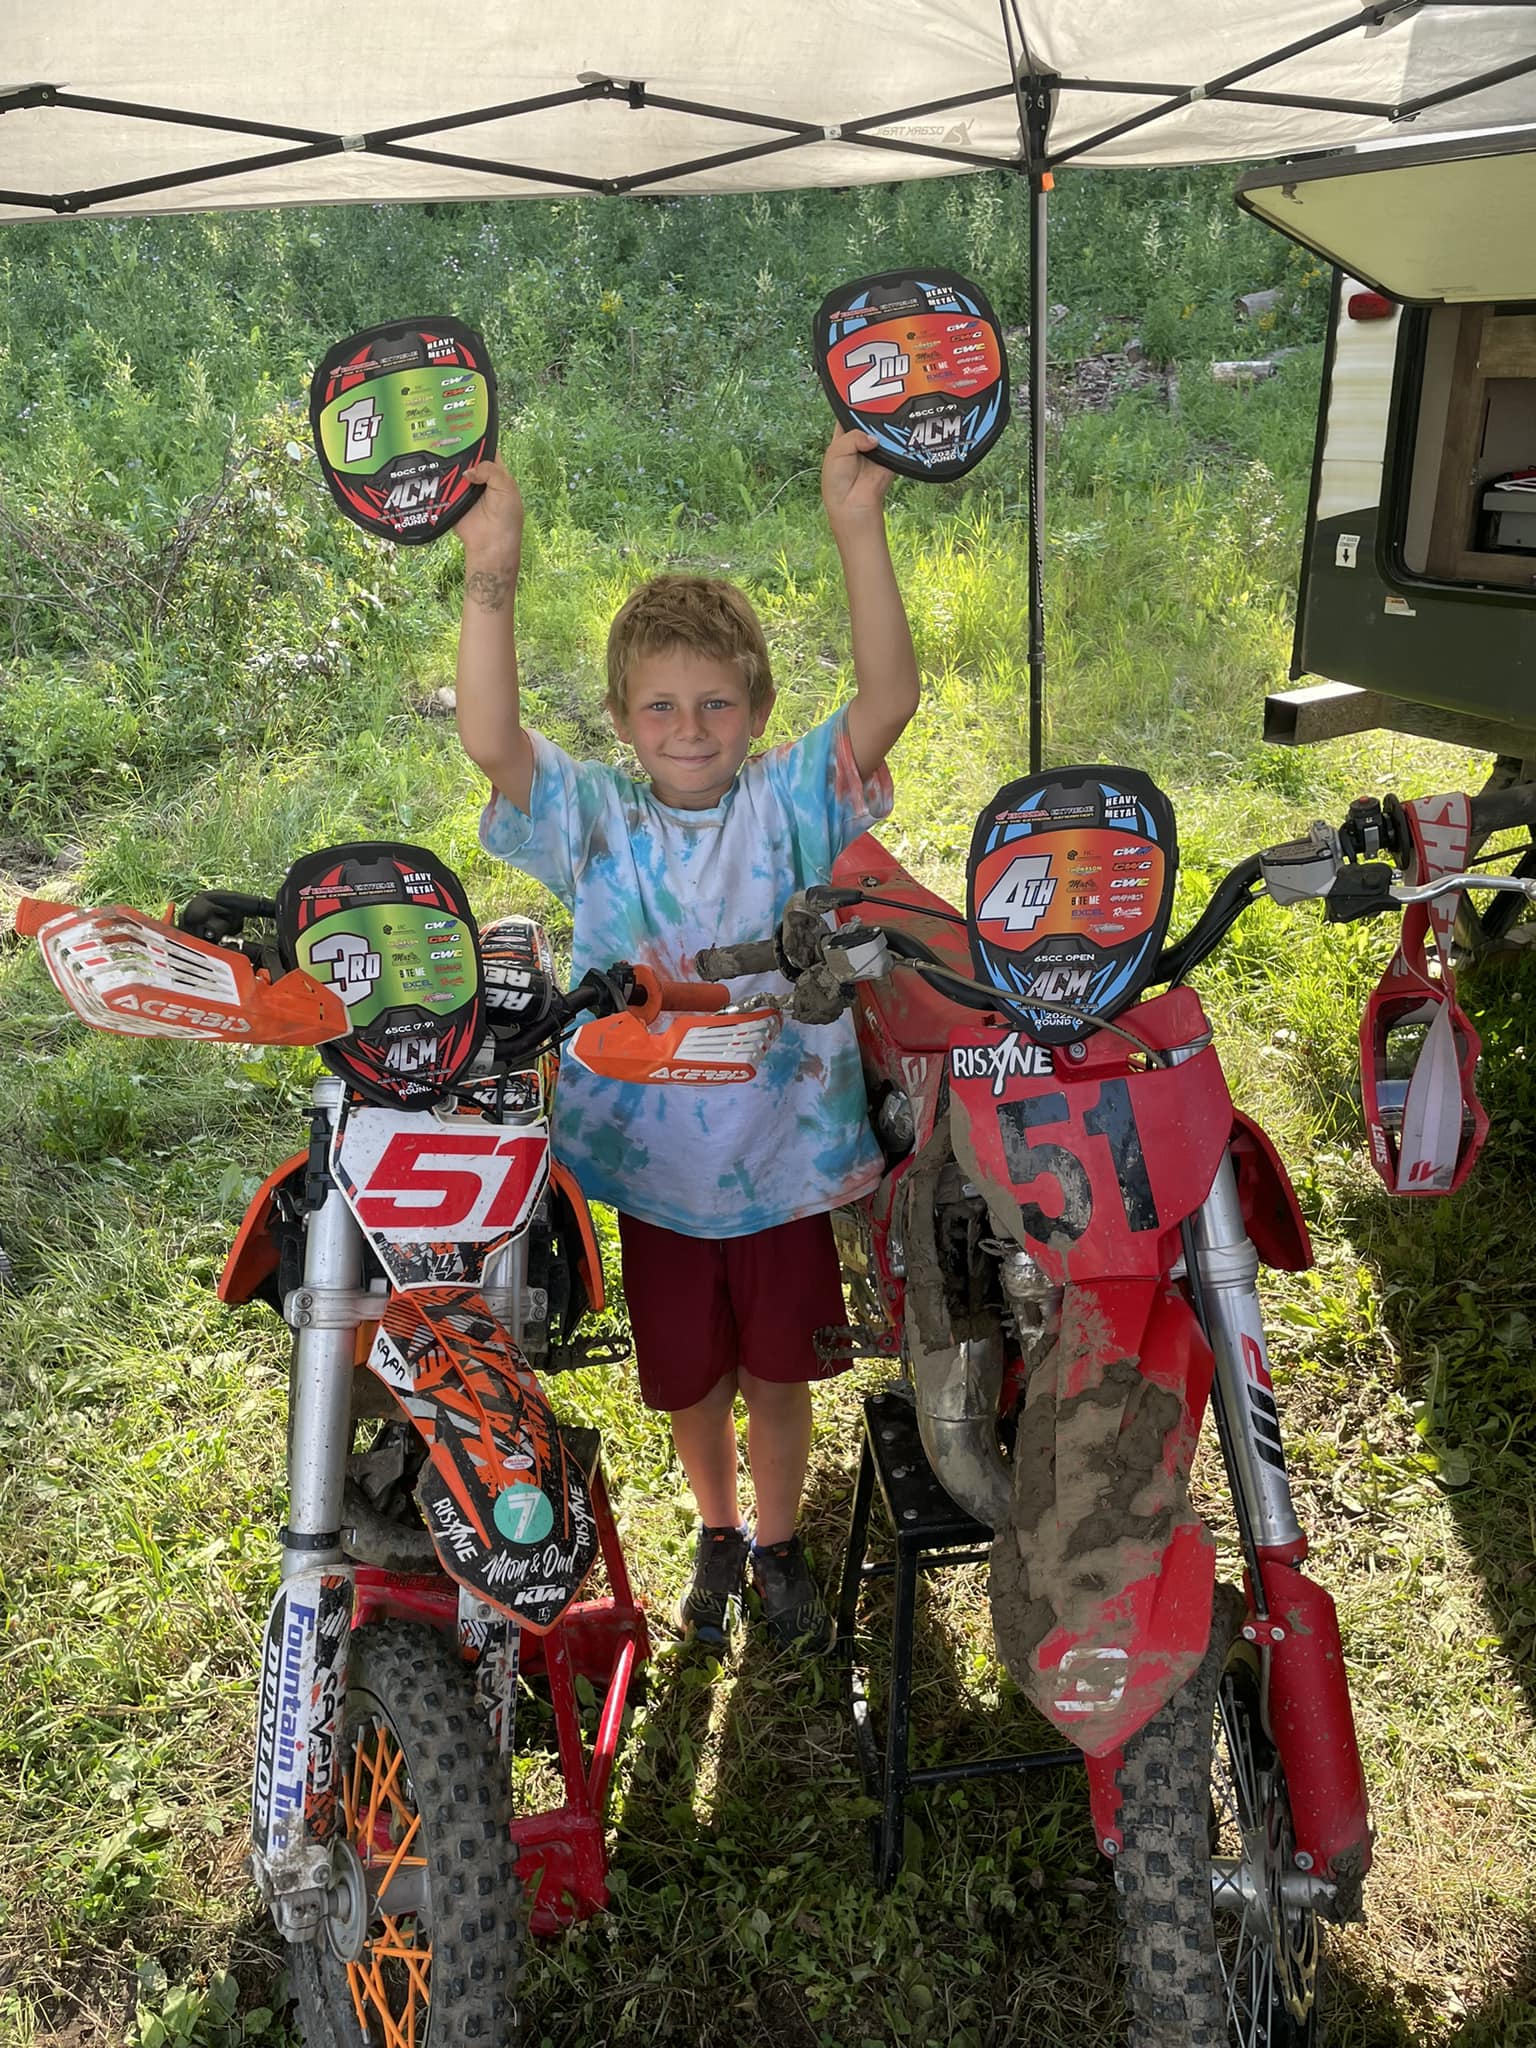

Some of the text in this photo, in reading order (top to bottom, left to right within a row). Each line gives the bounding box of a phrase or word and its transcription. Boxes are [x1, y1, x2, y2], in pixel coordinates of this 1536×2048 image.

[925, 286, 953, 298] HEAVY
[927, 295, 957, 306] METAL
[427, 337, 454, 350] HEAVY
[428, 346, 456, 359] METAL
[338, 396, 384, 463] 1ST
[908, 415, 962, 446] ACM
[923, 454, 956, 465] ROUND
[390, 467, 416, 479] 50CC
[384, 477, 440, 509] ACM
[394, 517, 428, 530] ROUND
[1105, 795, 1138, 806] HEAVY
[1105, 808, 1137, 819] METAL
[403, 872, 432, 883] HEAVY
[405, 884, 435, 895] METAL
[977, 854, 1058, 932] 4TH
[1089, 895, 1101, 904] ME
[1034, 953, 1095, 962] 65CC OPEN
[310, 932, 382, 1008] 3RD
[1025, 966, 1092, 1001] ACM
[384, 1024, 412, 1035] 65CC
[1034, 1018, 1071, 1026] ROUND
[384, 1037, 437, 1073] ACM
[1370, 1122, 1388, 1164] SHIFT
[996, 1078, 1160, 1244] 51
[355, 1132, 549, 1228] 51
[507, 1492, 541, 1540] 7
[481, 1543, 580, 1586] Mom & Dad
[514, 1584, 567, 1606] KTM
[277, 1601, 317, 1773] Fountain
[255, 1637, 281, 1829] DUNLOP
